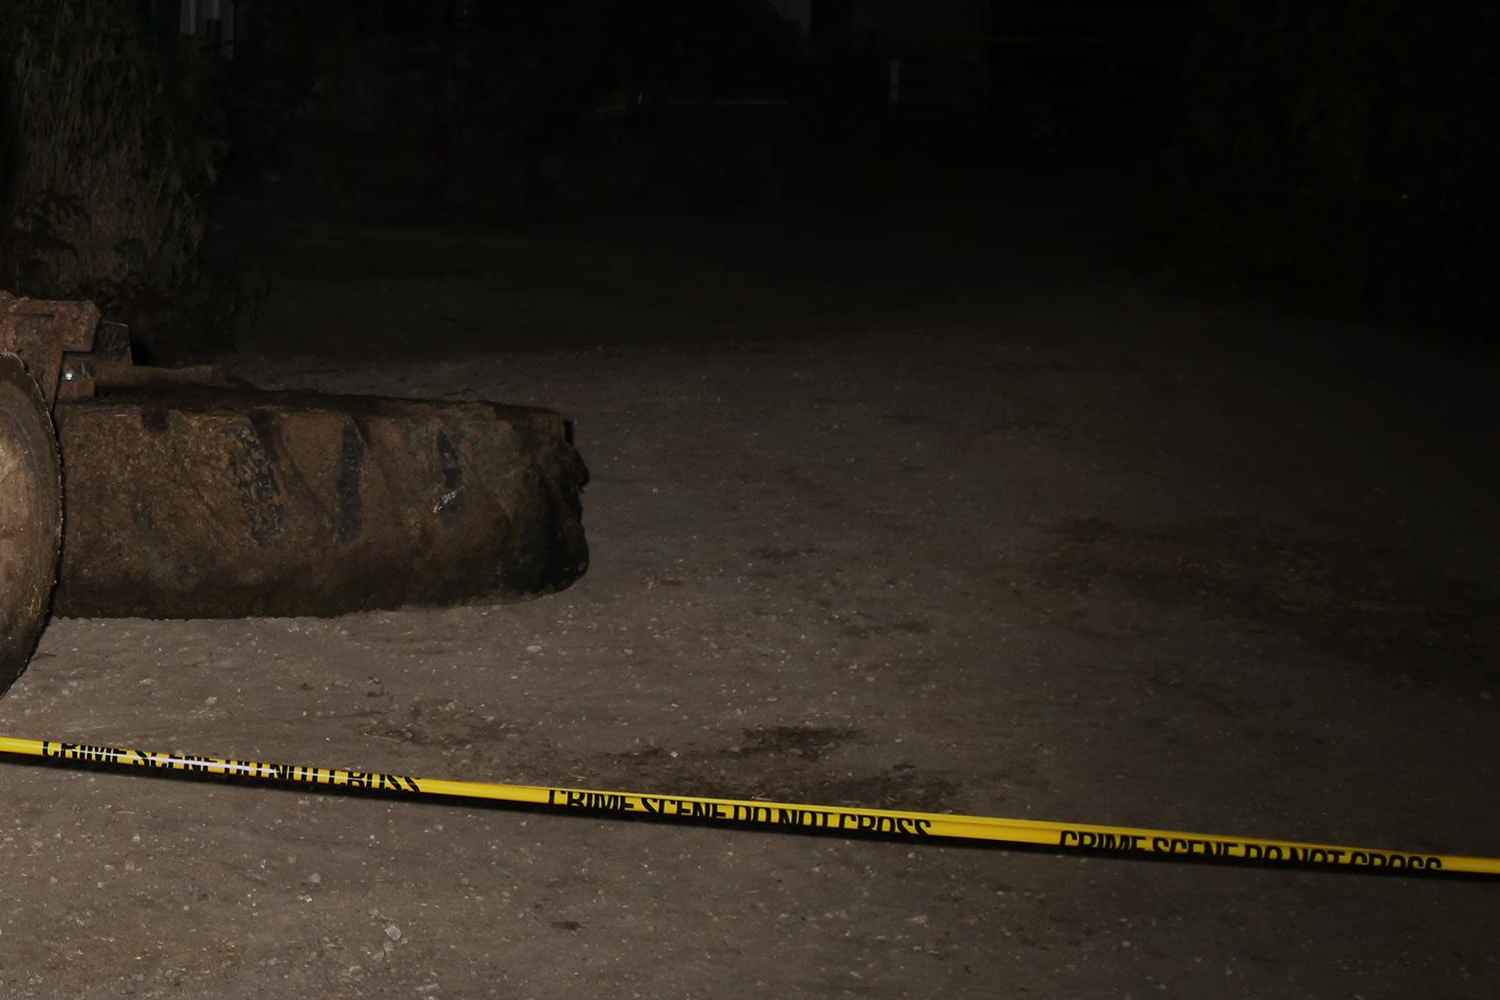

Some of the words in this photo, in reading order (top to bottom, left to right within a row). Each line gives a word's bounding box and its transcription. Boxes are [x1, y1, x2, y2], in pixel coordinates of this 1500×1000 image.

[1060, 830, 1147, 852] CRIME
[1152, 838, 1239, 860] SCENE
[1245, 844, 1283, 864] DO
[1289, 847, 1346, 868] NOT
[1350, 852, 1443, 874] CROSS
